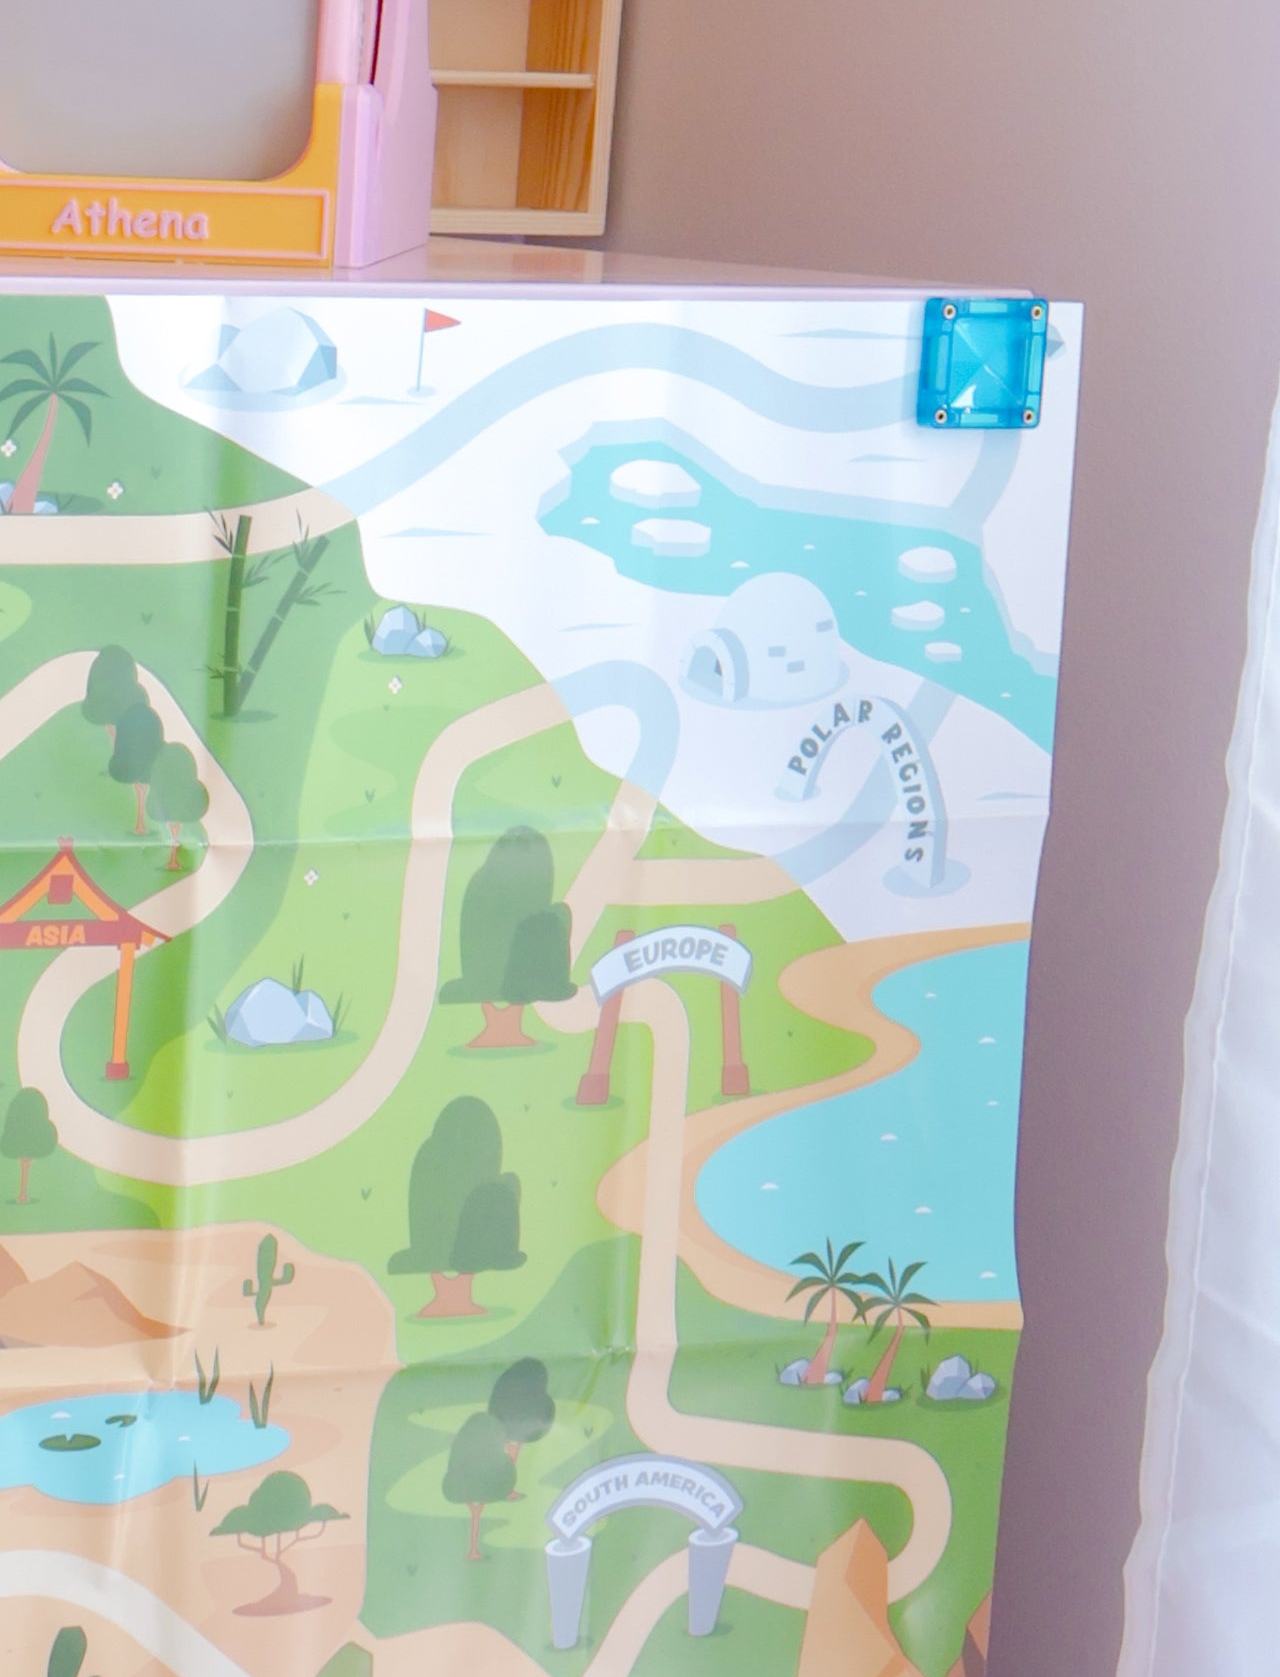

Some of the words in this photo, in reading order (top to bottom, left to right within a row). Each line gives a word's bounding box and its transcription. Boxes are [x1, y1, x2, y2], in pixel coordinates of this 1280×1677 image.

[51, 199, 210, 240] Athena
[787, 700, 873, 776] POLAR
[881, 722, 929, 863] REGIONS
[25, 924, 86, 946] ASIA
[624, 936, 729, 972] EUROPE
[562, 1474, 629, 1527] SOUTH
[635, 1471, 726, 1519] AMERICA
